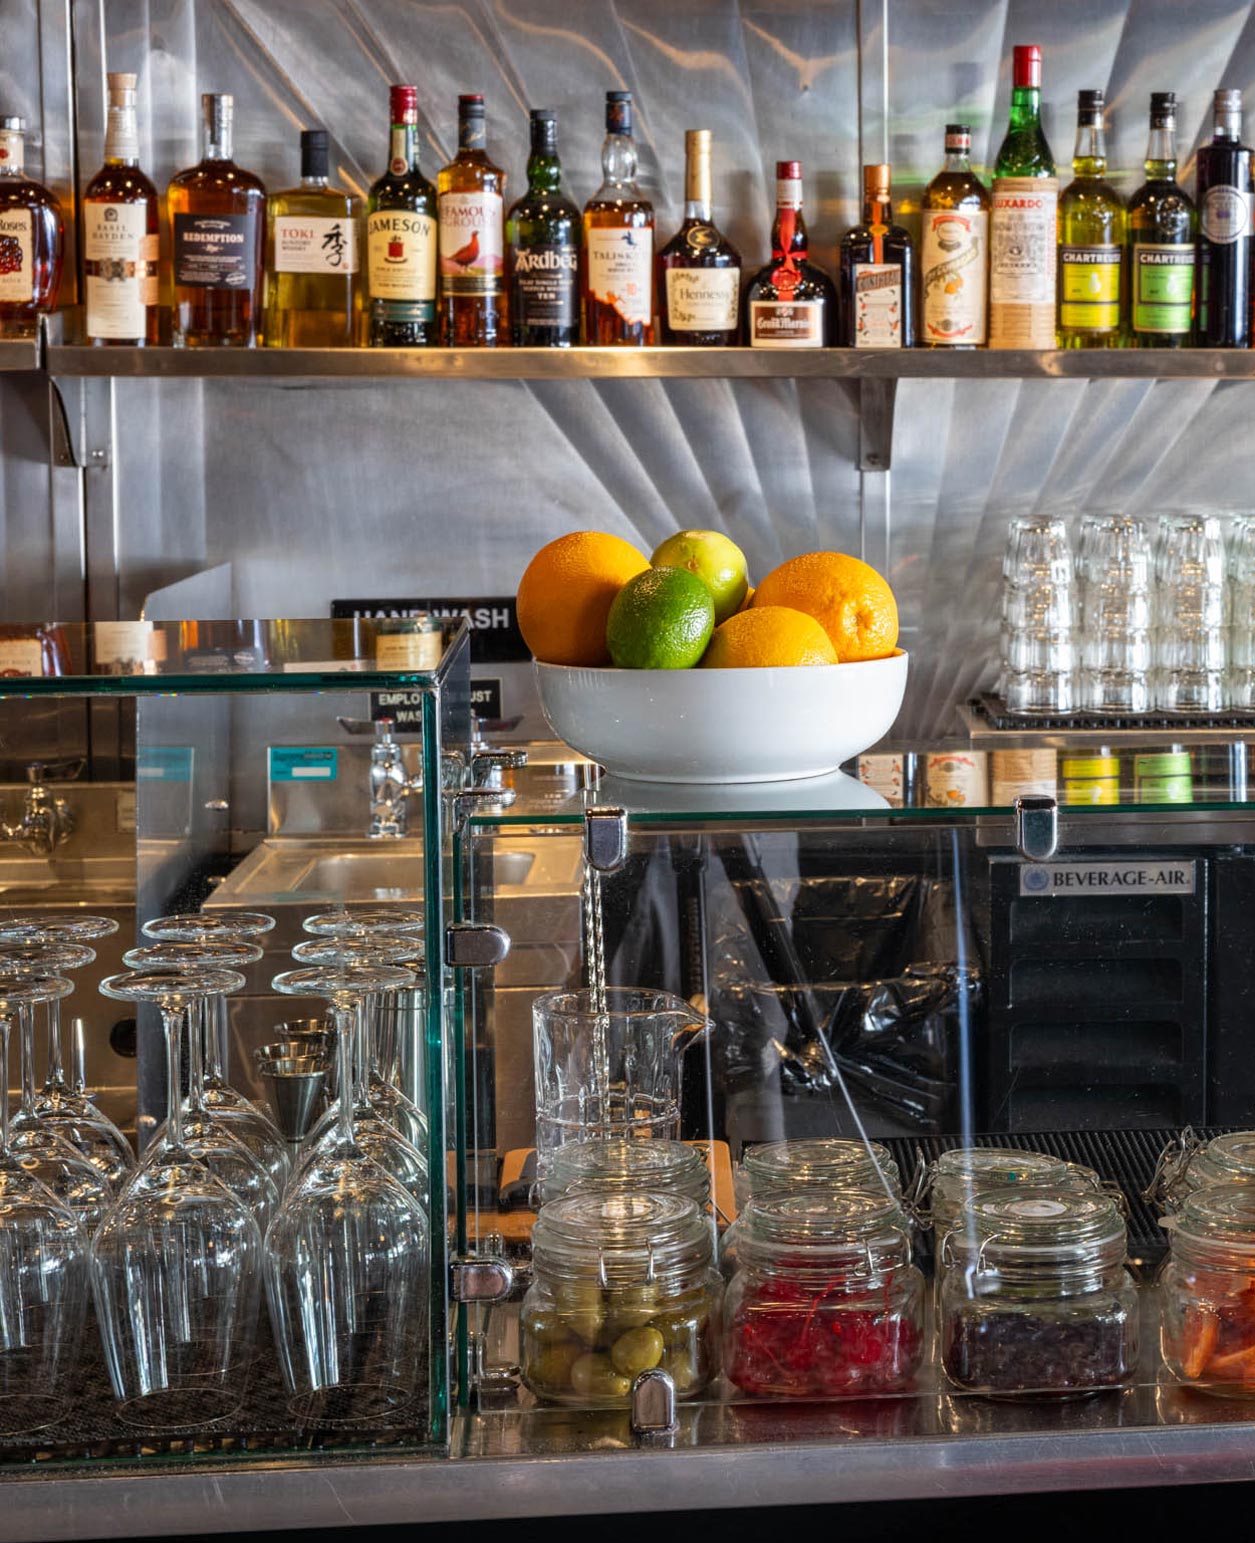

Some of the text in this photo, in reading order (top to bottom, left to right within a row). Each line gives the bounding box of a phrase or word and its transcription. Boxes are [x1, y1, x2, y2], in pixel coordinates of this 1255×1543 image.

[368, 218, 430, 237] JAMESON
[593, 251, 634, 261] TALISK
[1140, 254, 1196, 264] CHARTREU
[396, 710, 421, 723] WAS
[1053, 870, 1185, 887] BEVERAGE-AIR
